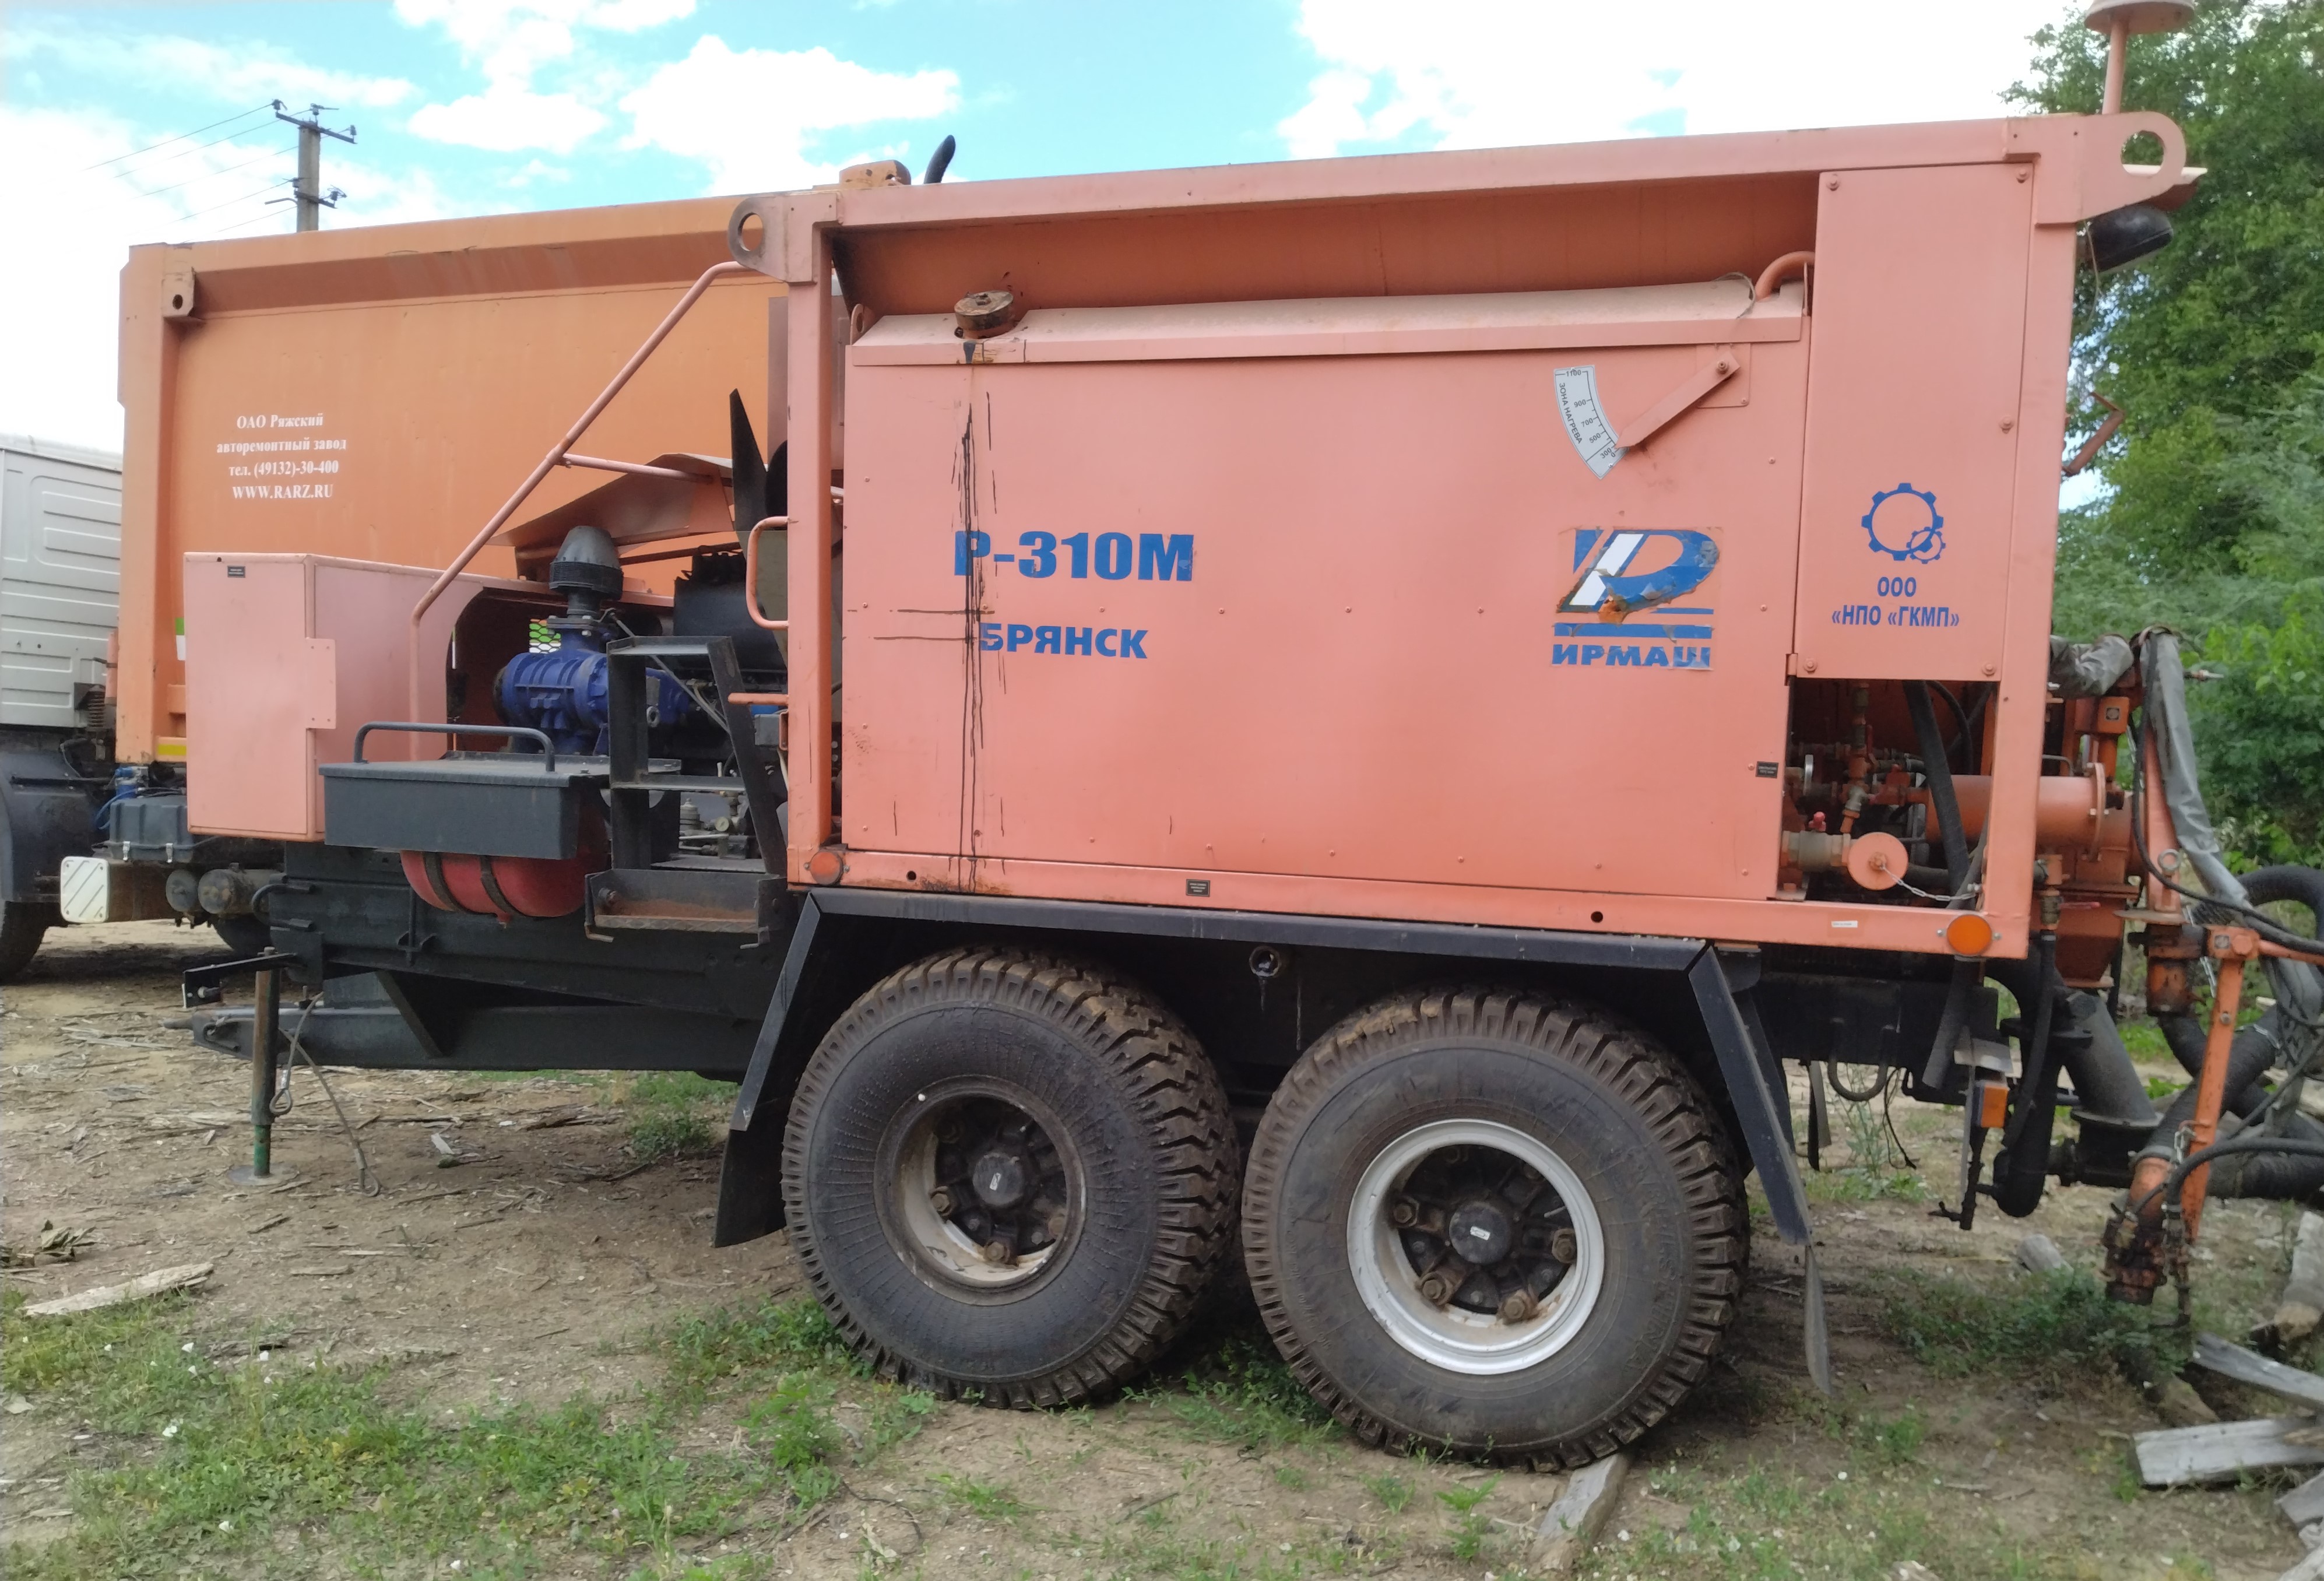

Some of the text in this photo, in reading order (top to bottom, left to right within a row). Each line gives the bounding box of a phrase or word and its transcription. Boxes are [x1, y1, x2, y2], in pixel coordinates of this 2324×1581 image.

[1566, 369, 1581, 377] 1100
[1574, 399, 1586, 407] 900
[237, 413, 324, 428] ОАО Ряжский
[1559, 382, 1583, 444] ЗОНА НАГРЕВА
[1581, 417, 1593, 427] 700
[217, 437, 346, 456] авторемонтный завод
[1589, 433, 1601, 443] 500
[1600, 447, 1612, 459] 300
[229, 460, 339, 479] тел. (49132)-30-400
[232, 484, 333, 499] WWW.RARZ.RU
[954, 530, 1194, 582] Р-310М
[1878, 577, 1917, 597] ООО
[1831, 605, 1959, 627] «НПО «ГКМП»
[979, 622, 1148, 659] БРЯНСК
[1552, 644, 1711, 667] ИРМАШ
